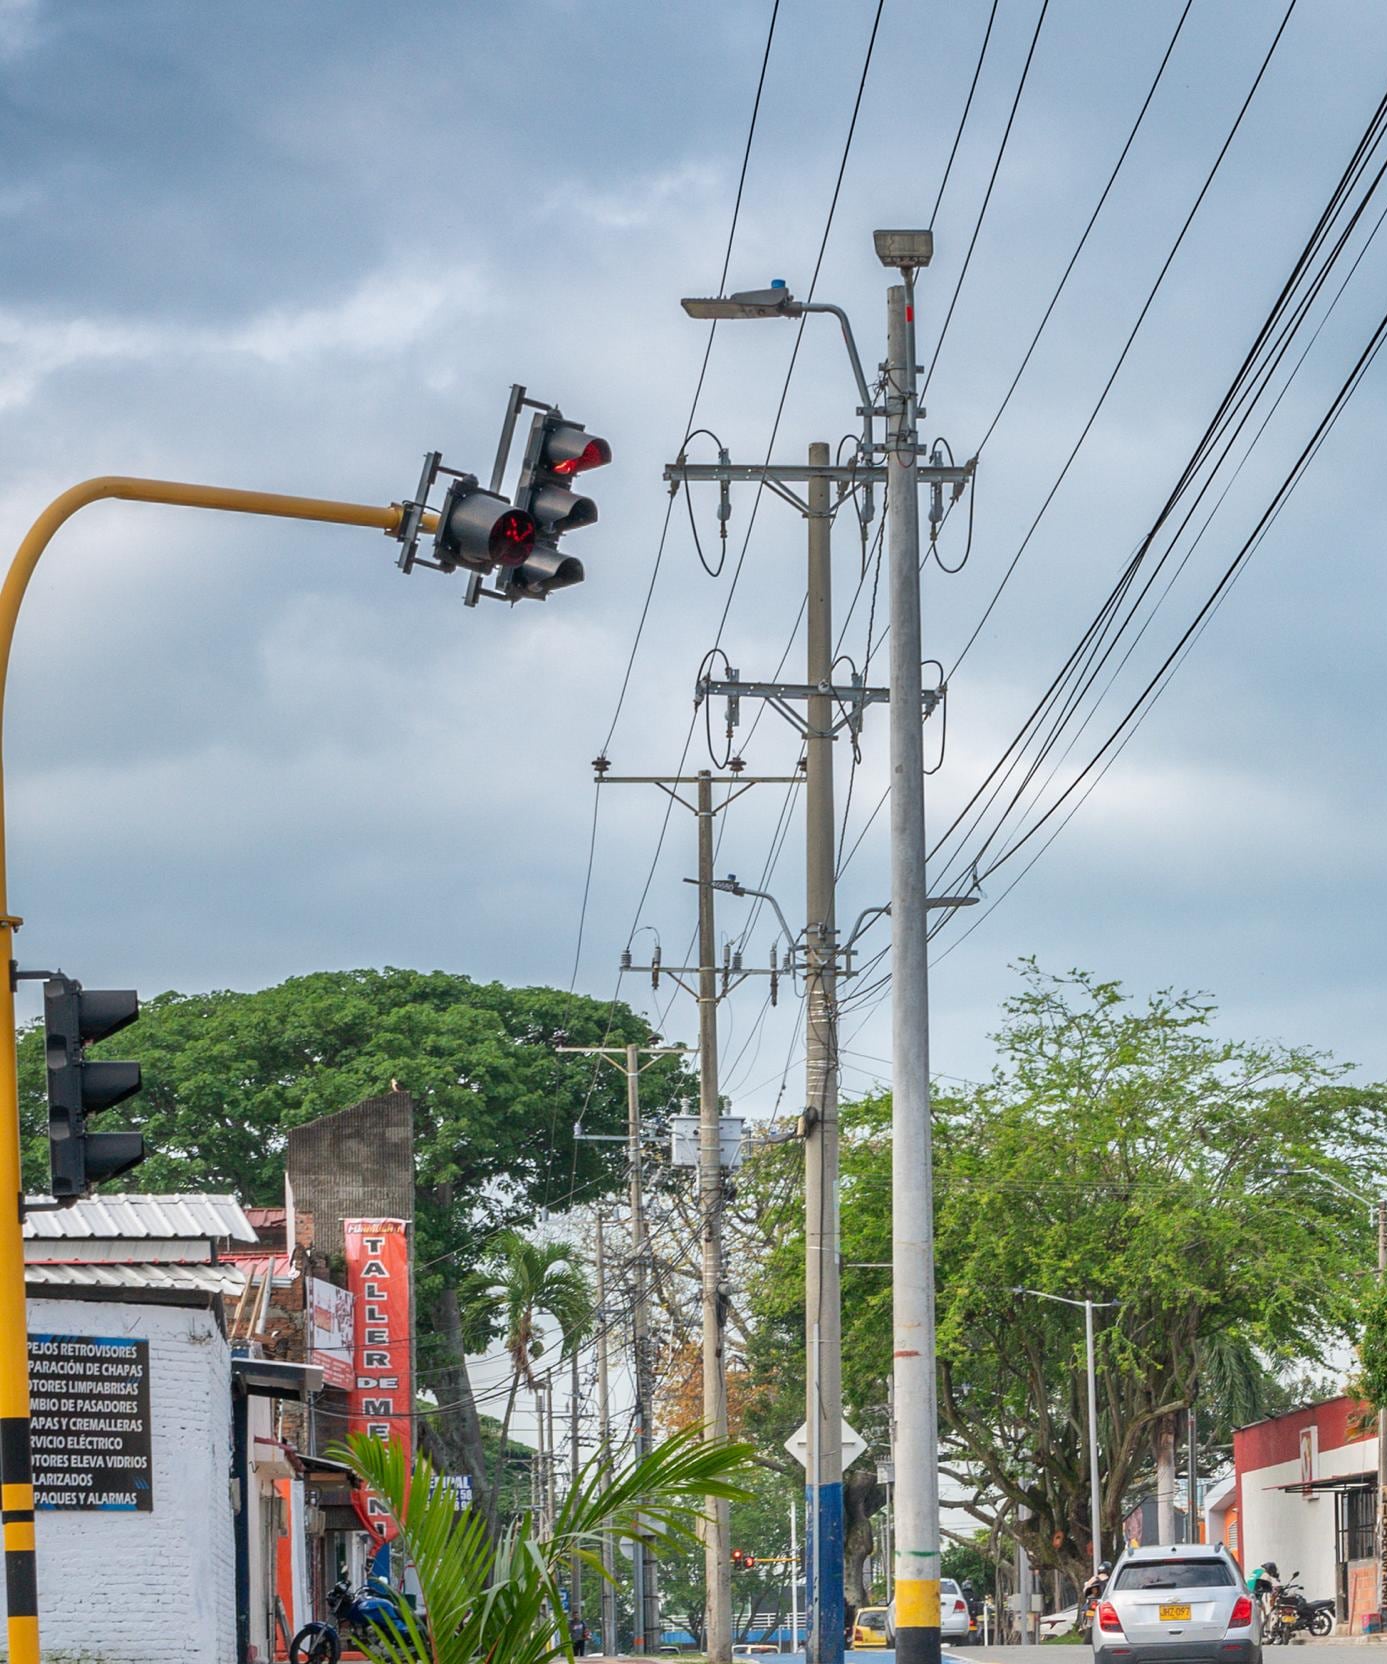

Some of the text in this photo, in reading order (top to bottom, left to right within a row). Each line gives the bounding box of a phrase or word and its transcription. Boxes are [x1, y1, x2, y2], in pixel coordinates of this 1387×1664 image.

[360, 1236, 391, 1368] TALLER
[28, 1342, 137, 1358] PEJOS RETROVISORES
[28, 1359, 142, 1377] PARACIÓN DE CHAPAS
[68, 1381, 138, 1395] LIMPIABRISAS
[357, 1377, 399, 1389] DE
[30, 1398, 138, 1413] MBIO DE PASADORES
[31, 1417, 142, 1432] APAS Y CREMALLERAS
[31, 1434, 123, 1449] RVICIO ELÉCTRICO
[71, 1455, 105, 1468] ELEVA
[106, 1456, 147, 1468] VIDRIOS
[32, 1473, 93, 1486] LARIZADOS
[34, 1491, 137, 1505] PAQUES Y ALARMAS
